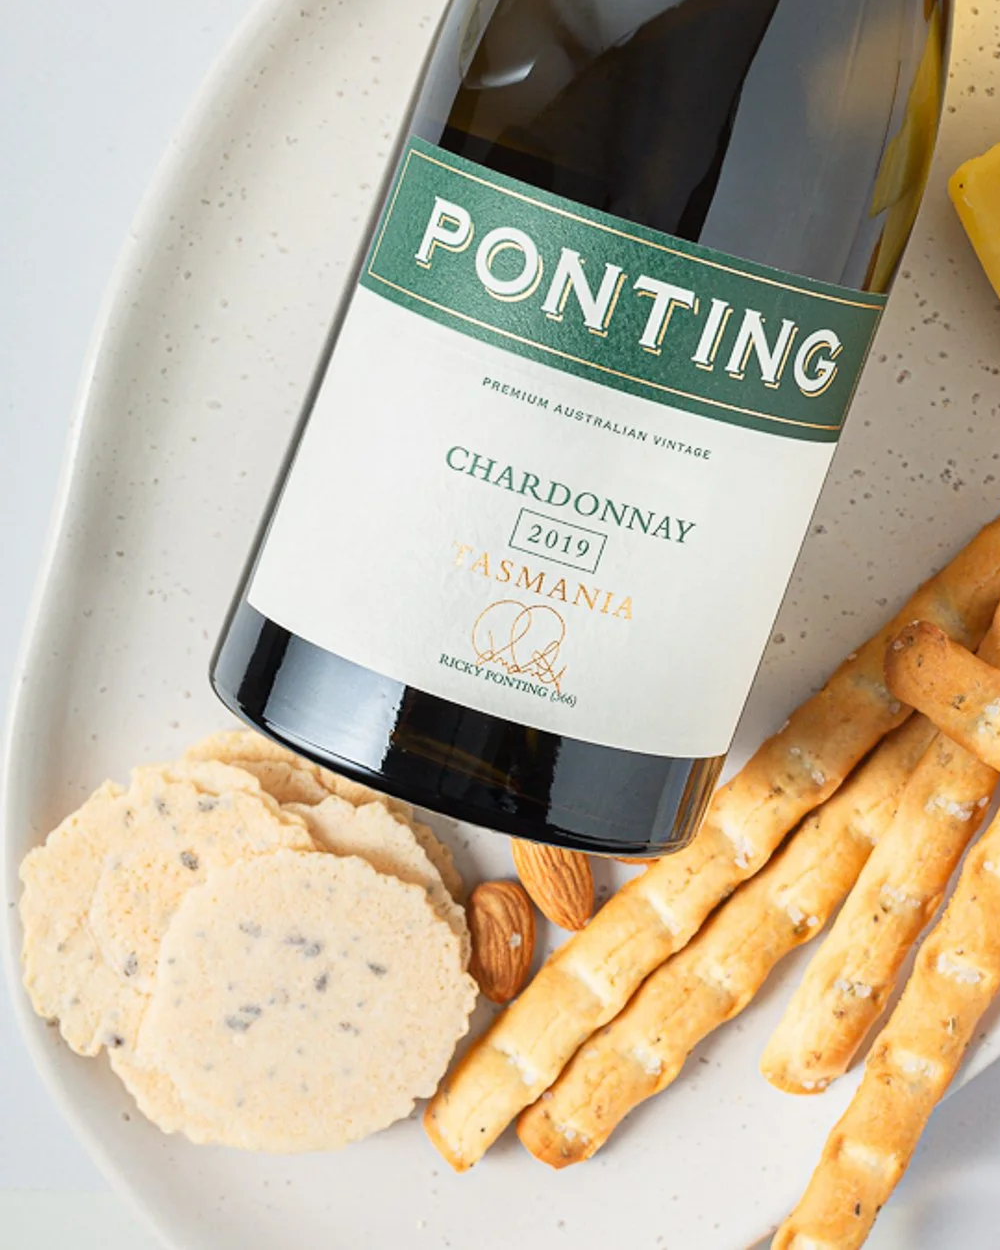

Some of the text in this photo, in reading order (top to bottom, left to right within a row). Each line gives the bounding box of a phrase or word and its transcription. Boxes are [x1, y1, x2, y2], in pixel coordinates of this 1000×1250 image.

[414, 195, 844, 397] PONTING
[482, 377, 712, 460] PREMIUM AUSTRALIAN VINTAGE
[445, 445, 696, 544] CHARDONNAY
[451, 540, 633, 620] TASMANIA
[527, 524, 591, 558] 2019
[438, 653, 484, 677] RICKY
[484, 669, 548, 697] PONTING
